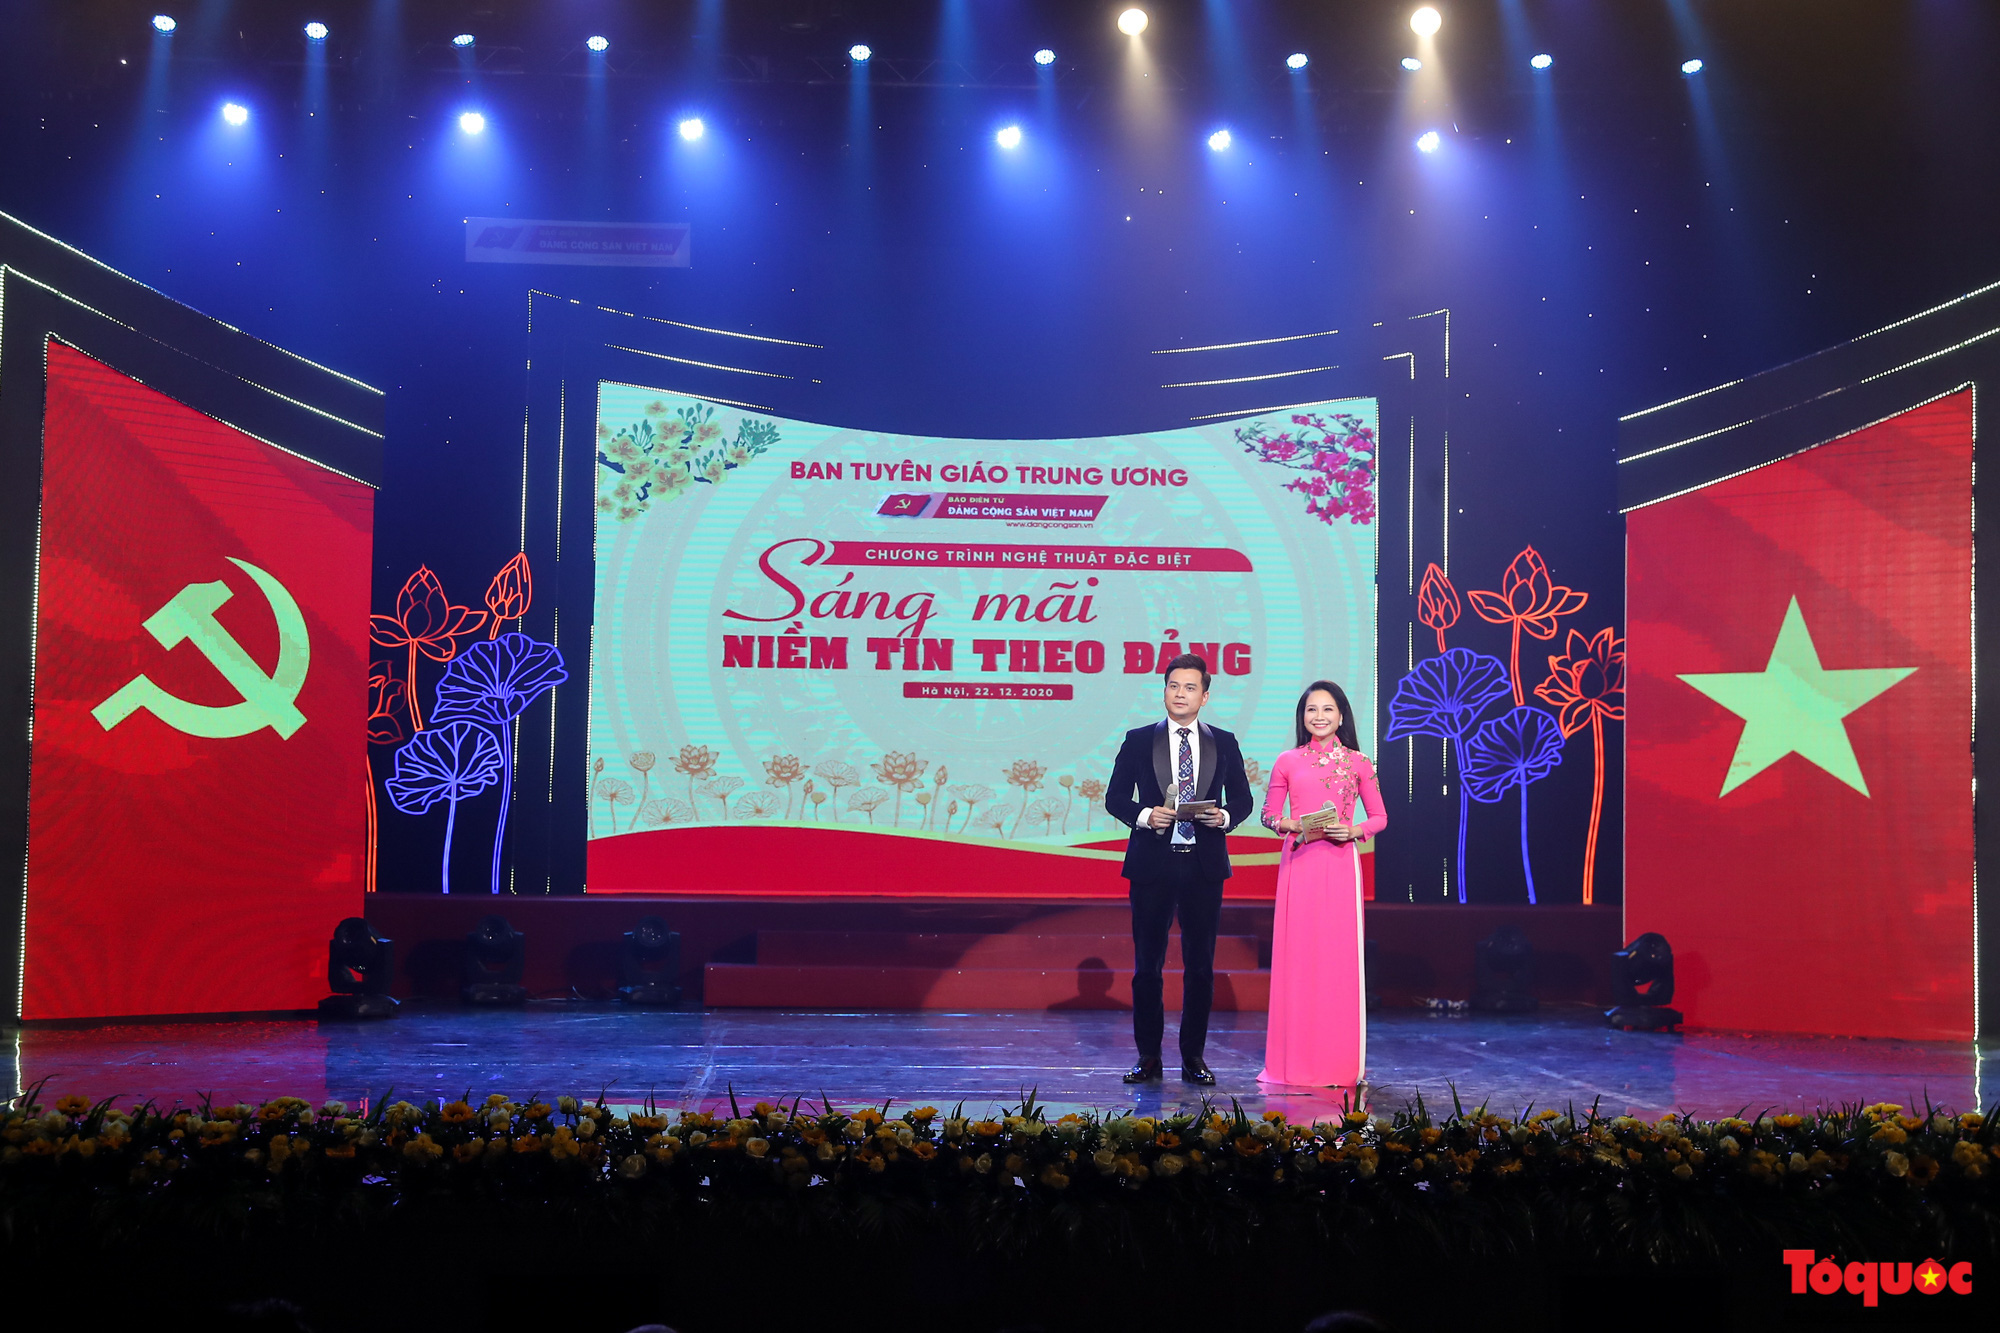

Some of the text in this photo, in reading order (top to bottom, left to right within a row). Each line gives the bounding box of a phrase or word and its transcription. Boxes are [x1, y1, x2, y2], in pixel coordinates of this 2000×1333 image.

[791, 459, 1189, 487] BAN TUYÊN GIÁO TRUNG ƯƠNG
[948, 504, 1093, 519] ĐẢNG CỘNG SẢN VIỆT NAM
[1005, 521, 1094, 530] www.dangcongsan.vn
[865, 548, 1192, 568] CHƯƠNG TRÌNH NGHỆ THUẬT ĐẶC BIỆT
[722, 538, 1099, 642] Sáng mãi
[722, 621, 1252, 676] NIỀM TIN THEO ĐẢNG
[922, 687, 1054, 698] Hà Nội, 22. 12. 2020
